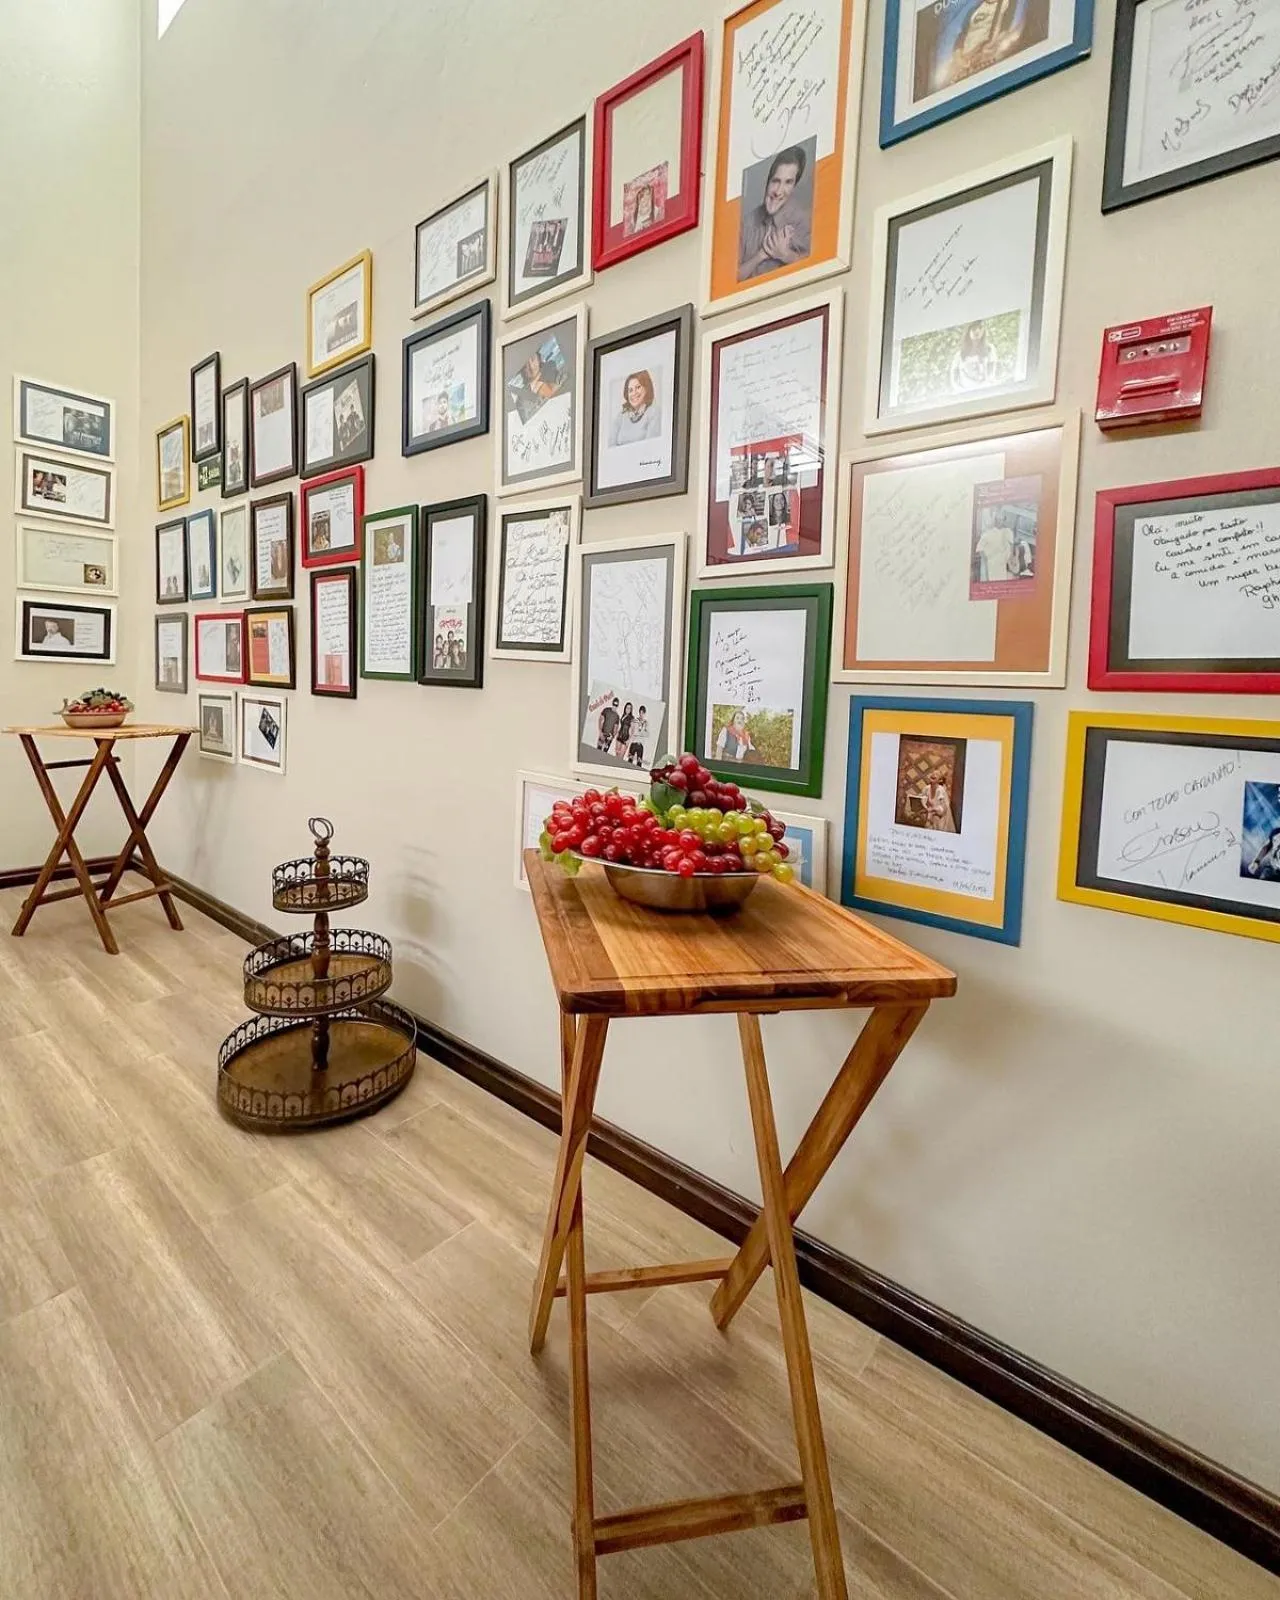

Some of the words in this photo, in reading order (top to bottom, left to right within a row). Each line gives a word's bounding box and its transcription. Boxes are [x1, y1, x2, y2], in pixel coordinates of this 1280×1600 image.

[1175, 514, 1206, 528] muito
[1155, 561, 1171, 573] Eu
[1176, 559, 1196, 568] me
[1239, 543, 1260, 552] em
[1149, 791, 1180, 812] TODO
